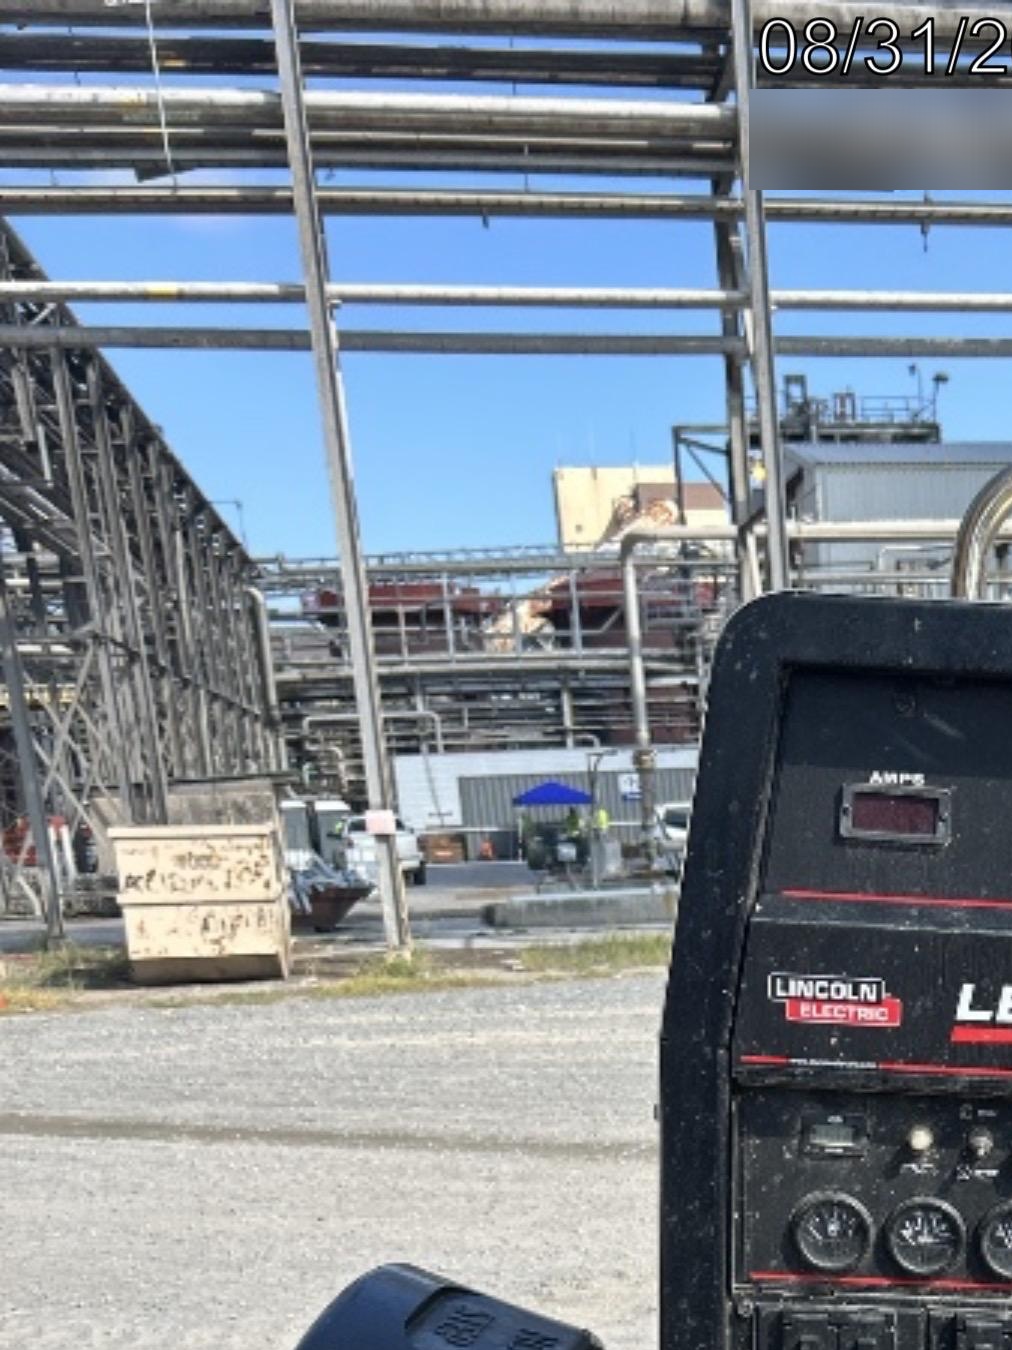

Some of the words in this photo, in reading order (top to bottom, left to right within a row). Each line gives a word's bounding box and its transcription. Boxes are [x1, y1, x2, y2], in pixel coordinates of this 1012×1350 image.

[869, 770, 925, 785] AMPS
[775, 977, 878, 1003] LINCOLN
[800, 1001, 889, 1022] ELECTRIC
